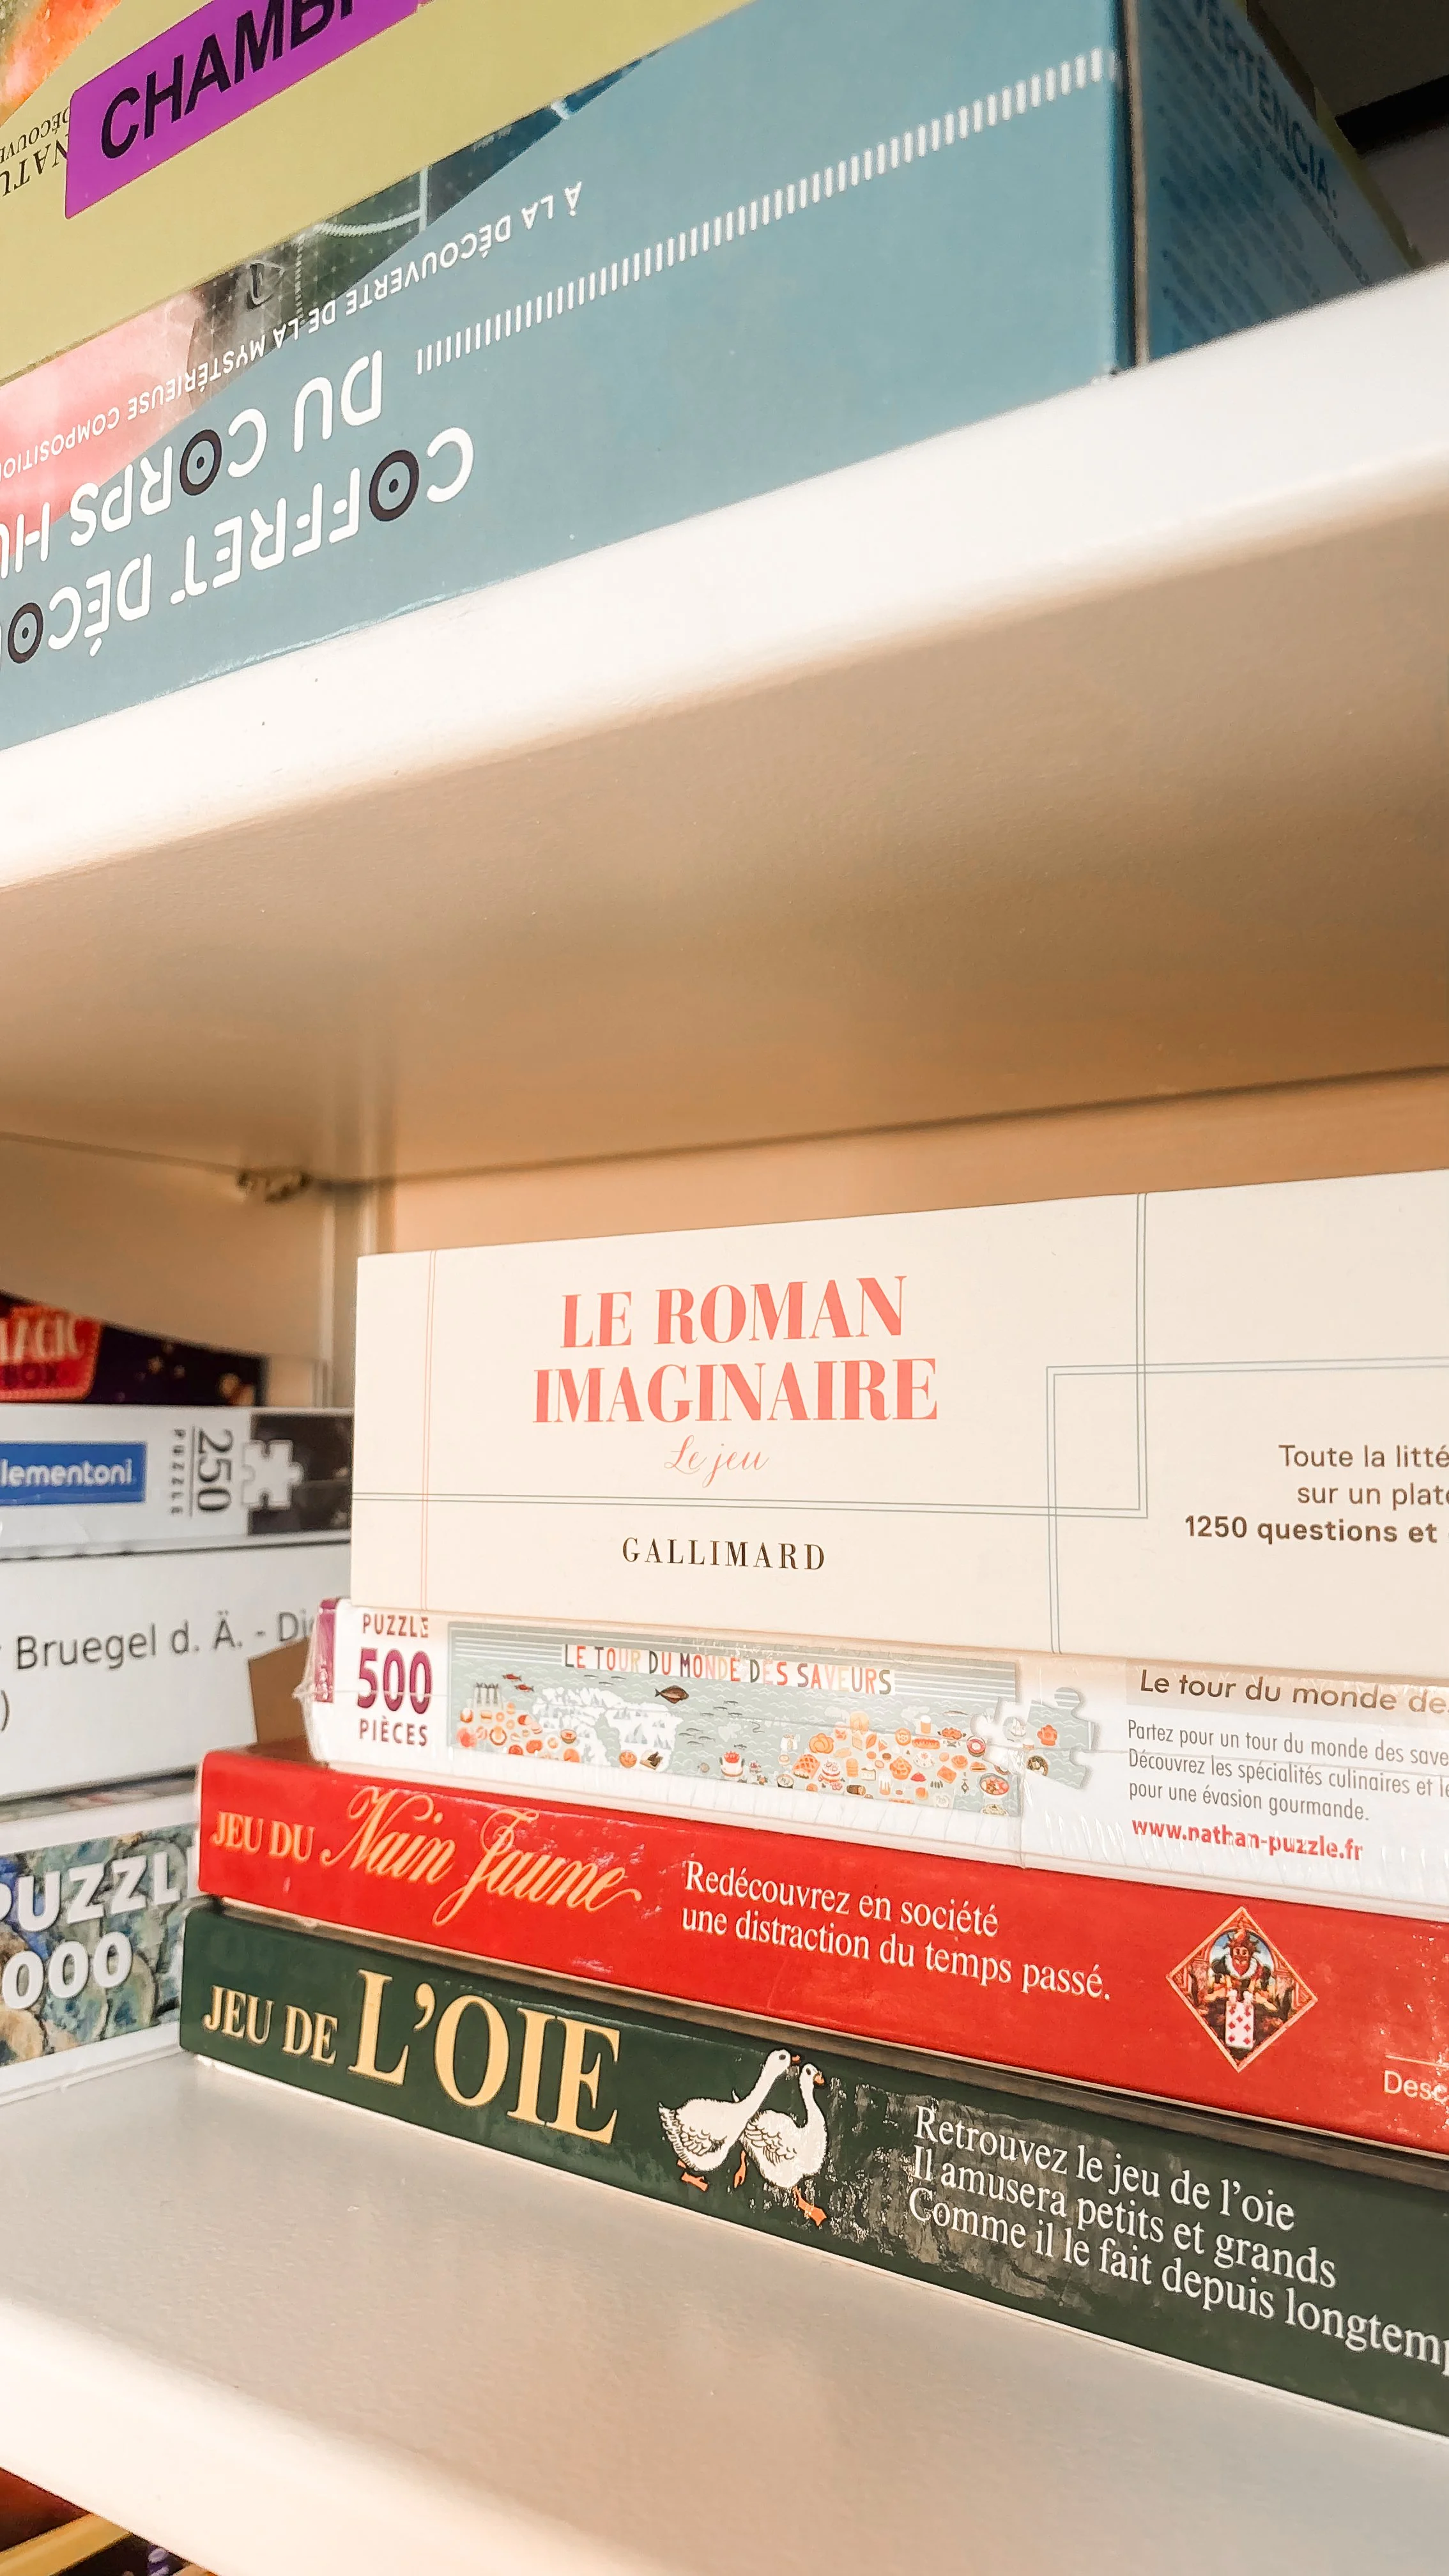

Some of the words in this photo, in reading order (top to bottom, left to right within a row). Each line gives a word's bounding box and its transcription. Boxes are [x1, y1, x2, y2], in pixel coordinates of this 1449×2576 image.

[100, 0, 353, 159] CHAMB
[521, 194, 554, 231] LA
[563, 180, 583, 217] À
[345, 214, 512, 318] DÉCOUVERTE
[273, 318, 299, 349] LA
[308, 298, 337, 334] DE
[127, 334, 266, 421] MYSTÉRIEUSE
[293, 349, 383, 453] DU
[0, 406, 120, 479] COMPOSITIO
[70, 408, 268, 547] CORPS
[170, 427, 475, 605] COFFRET
[0, 553, 153, 664] DÉCO
[560, 1290, 632, 1349] LE
[654, 1275, 907, 1345] ROMAN
[532, 1358, 938, 1423] IMAGINAIRE
[197, 1427, 234, 1513] 250
[663, 1434, 707, 1475] Le
[702, 1442, 770, 1488] jeu
[1278, 1444, 1353, 1468] Toute
[1363, 1444, 1385, 1468] la
[1395, 1443, 1449, 1468] litté
[1297, 1486, 1338, 1504] sur
[1349, 1487, 1381, 1505] un
[1392, 1482, 1449, 1511] plat
[622, 1536, 824, 1570] GALLIMARD
[1184, 1514, 1247, 1538] 1250
[1257, 1517, 1398, 1545] questions
[1408, 1523, 1438, 1544] et
[16, 1621, 157, 1670] Bruegel
[170, 1620, 200, 1654] d.
[212, 1609, 243, 1651] Ä.
[362, 1613, 429, 1638] PUZZLE
[356, 1646, 433, 1714] 500
[564, 1643, 587, 1669] LE
[594, 1645, 641, 1672] TOUR
[648, 1649, 671, 1676] DU
[680, 1652, 742, 1683] MONDE
[749, 1658, 788, 1687] DES
[797, 1662, 892, 1696] SAVEURS
[1139, 1669, 1170, 1694] Le
[1179, 1674, 1236, 1698] tour
[1245, 1676, 1281, 1702] du
[1292, 1683, 1397, 1710] monde
[1408, 1688, 1449, 1715] de
[359, 1715, 428, 1747] PIÈCES
[1128, 1719, 1174, 1742] Partez
[1179, 1729, 1215, 1748] pour
[1220, 1733, 1239, 1749] un
[1245, 1731, 1278, 1751] tour
[1284, 1731, 1304, 1754] du
[1311, 1737, 1368, 1759] monde
[1375, 1738, 1404, 1763] des
[1409, 1748, 1449, 1767] save
[1129, 1748, 1206, 1774] Découvrez
[1211, 1754, 1232, 1777] les
[1238, 1759, 1322, 1786] spécialités
[1328, 1768, 1410, 1795] culinaires
[1416, 1778, 1433, 1797] et
[1129, 1782, 1163, 1800] pour
[1169, 1786, 1197, 1803] une
[1202, 1784, 1262, 1809] évasion
[1268, 1796, 1370, 1821] gourmande.
[210, 1811, 263, 1853] JEU
[270, 1821, 315, 1862] DU
[321, 1786, 457, 1885] Nain
[432, 1807, 643, 1926] Jaune
[1131, 1819, 1363, 1860] www.nathan-puzzle.fr
[684, 1860, 851, 1915] Redécouvrez
[859, 1894, 892, 1922] en
[900, 1897, 999, 1937] société
[682, 1906, 728, 1936] une
[735, 1909, 870, 1960] distraction
[879, 1933, 914, 1967] du
[925, 1941, 1013, 1987] temps
[1021, 1963, 1110, 2000] passé.
[203, 1985, 275, 2045] JEU
[284, 2005, 339, 2065] DE
[1383, 2069, 1448, 2104] Desc
[914, 2104, 1068, 2175] Retrouvez
[1076, 2144, 1103, 2183] le
[1107, 2153, 1160, 2198] jeu
[1170, 2169, 1211, 2210] de
[912, 2144, 933, 2182] Il
[940, 2162, 1067, 2218] amusera
[1077, 2198, 1164, 2244] petits
[1173, 2221, 1206, 2255] et
[1213, 2234, 1337, 2289] grands
[908, 2186, 1027, 2250] Comme
[1034, 2218, 1054, 2258] il
[1062, 2227, 1090, 2267] le
[1098, 2237, 1153, 2286] fait
[1161, 2257, 1276, 2320] depuis
